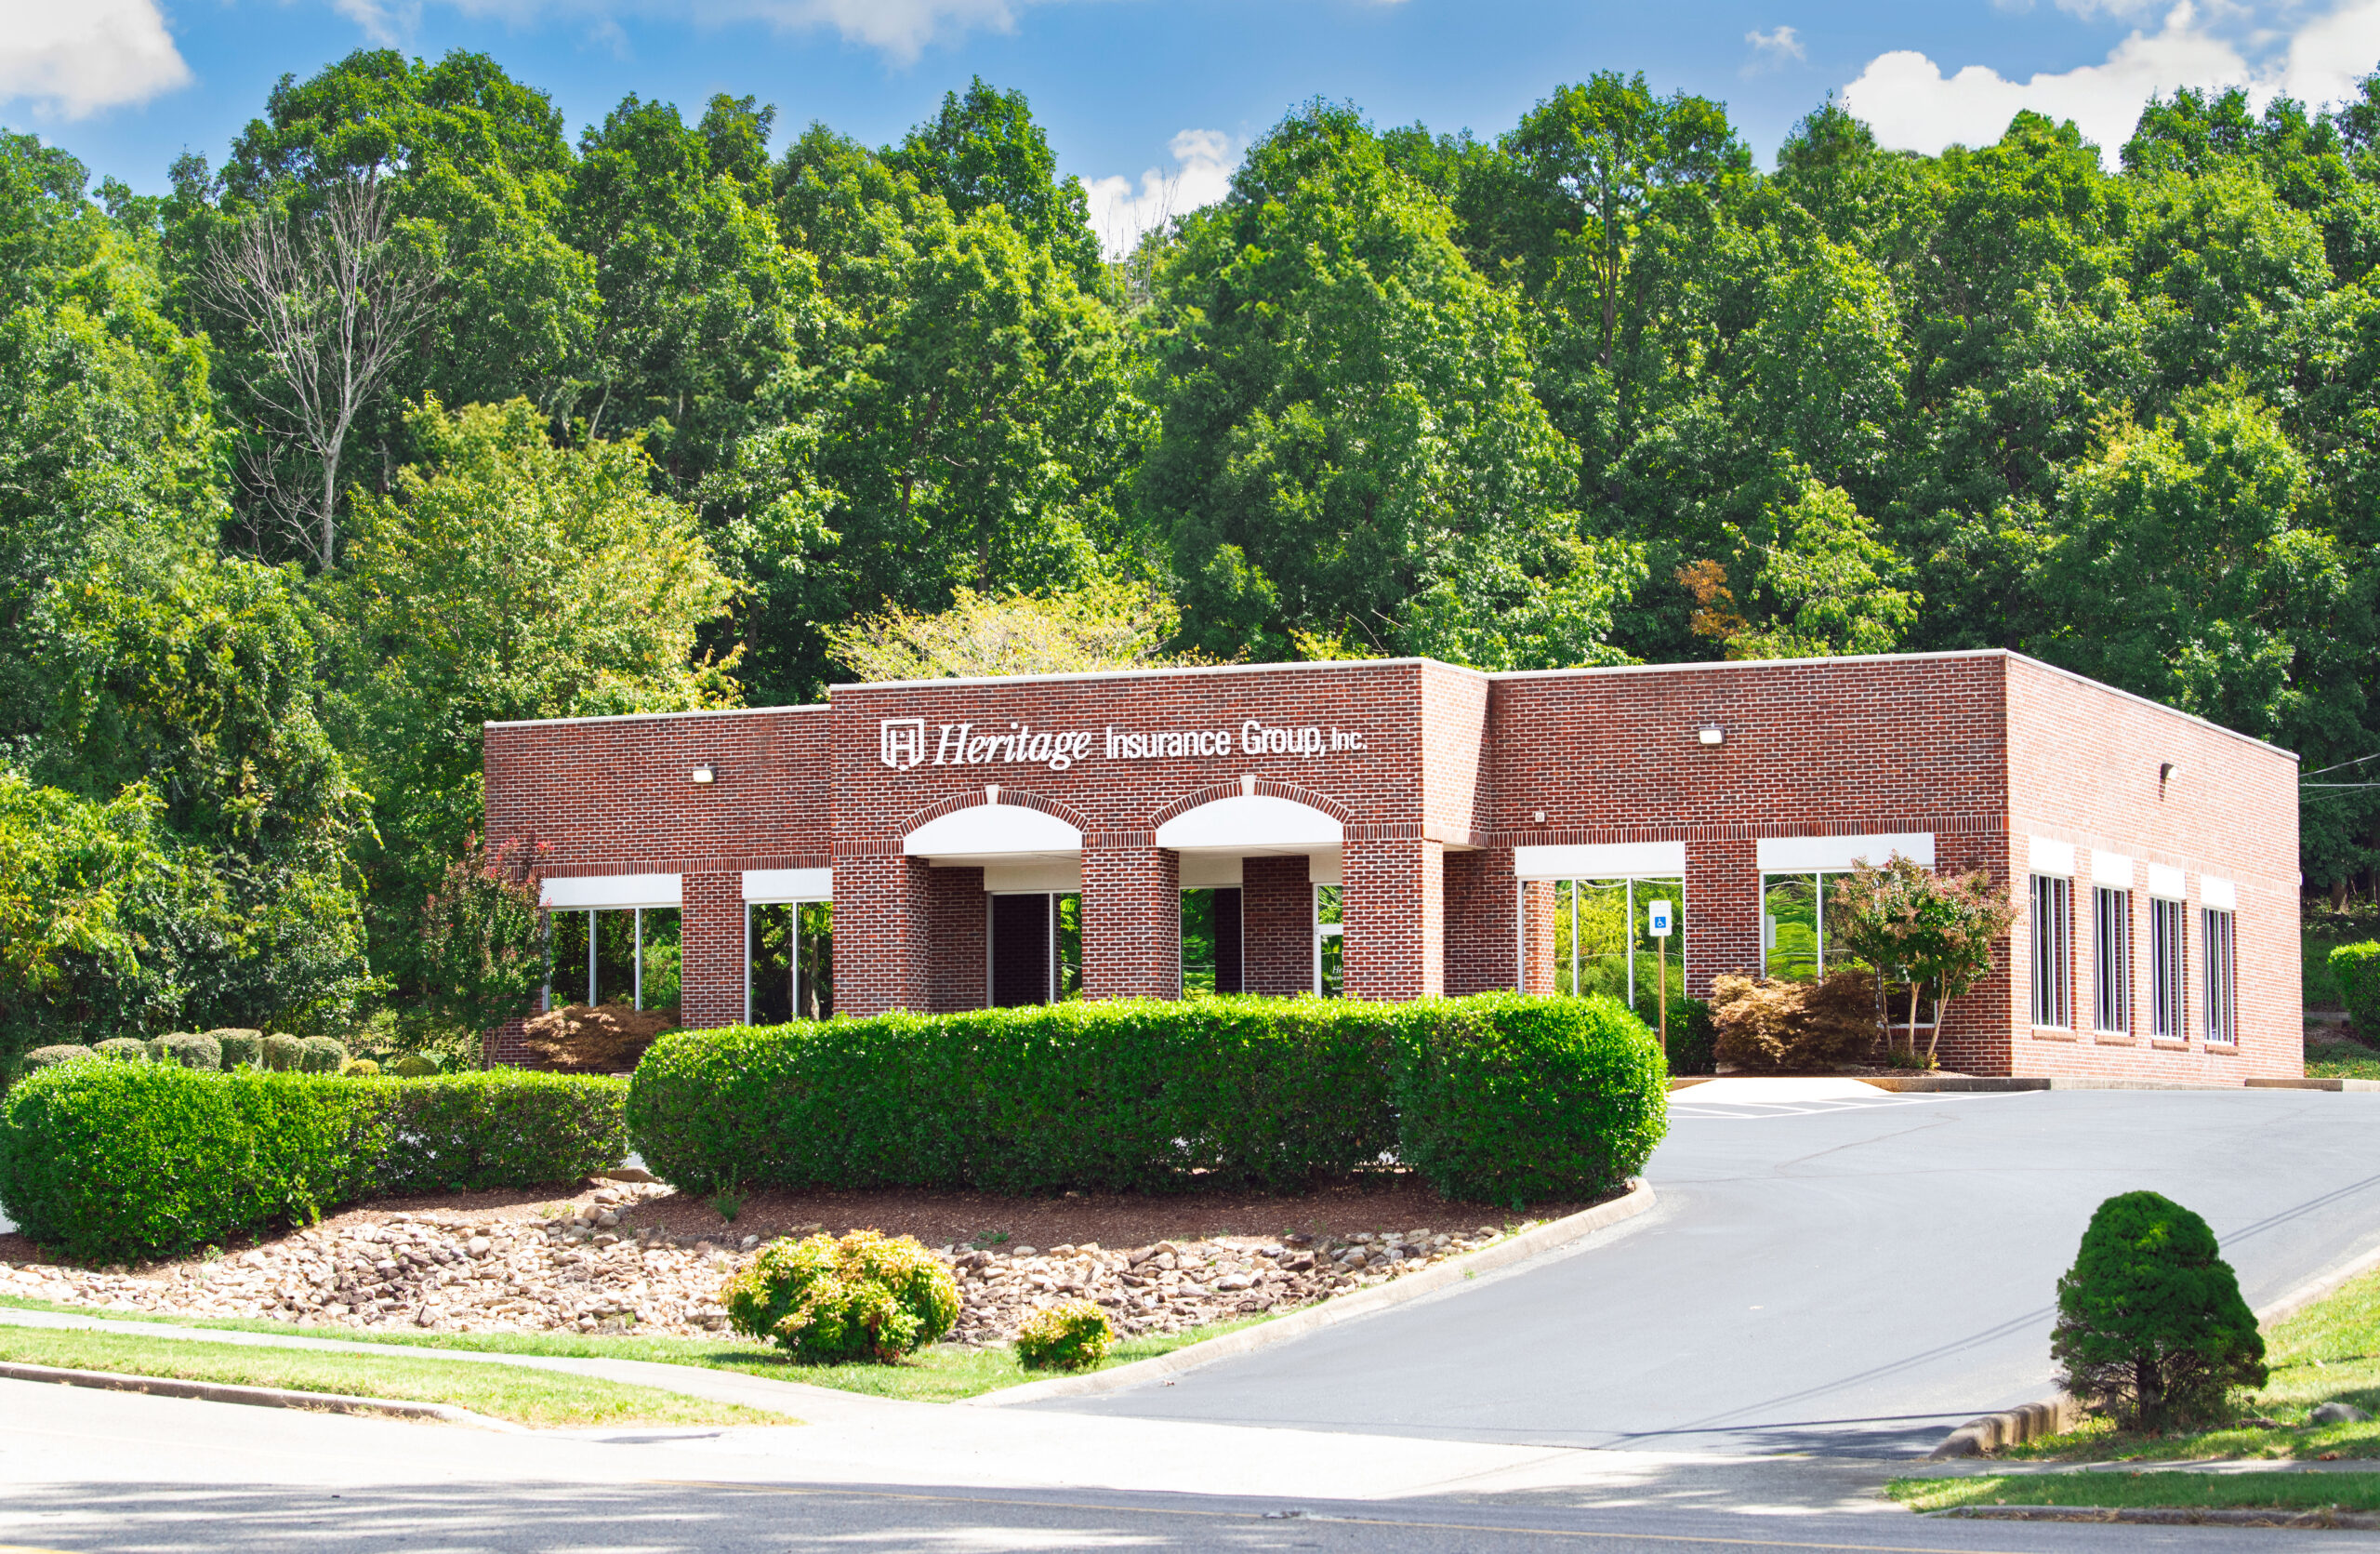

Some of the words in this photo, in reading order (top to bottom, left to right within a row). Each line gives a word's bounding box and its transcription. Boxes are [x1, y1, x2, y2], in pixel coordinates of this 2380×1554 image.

[932, 722, 1092, 771] Heritage
[1105, 725, 1231, 760] Insurance
[1241, 720, 1328, 758] Group,
[1331, 726, 1368, 750] Inc.
